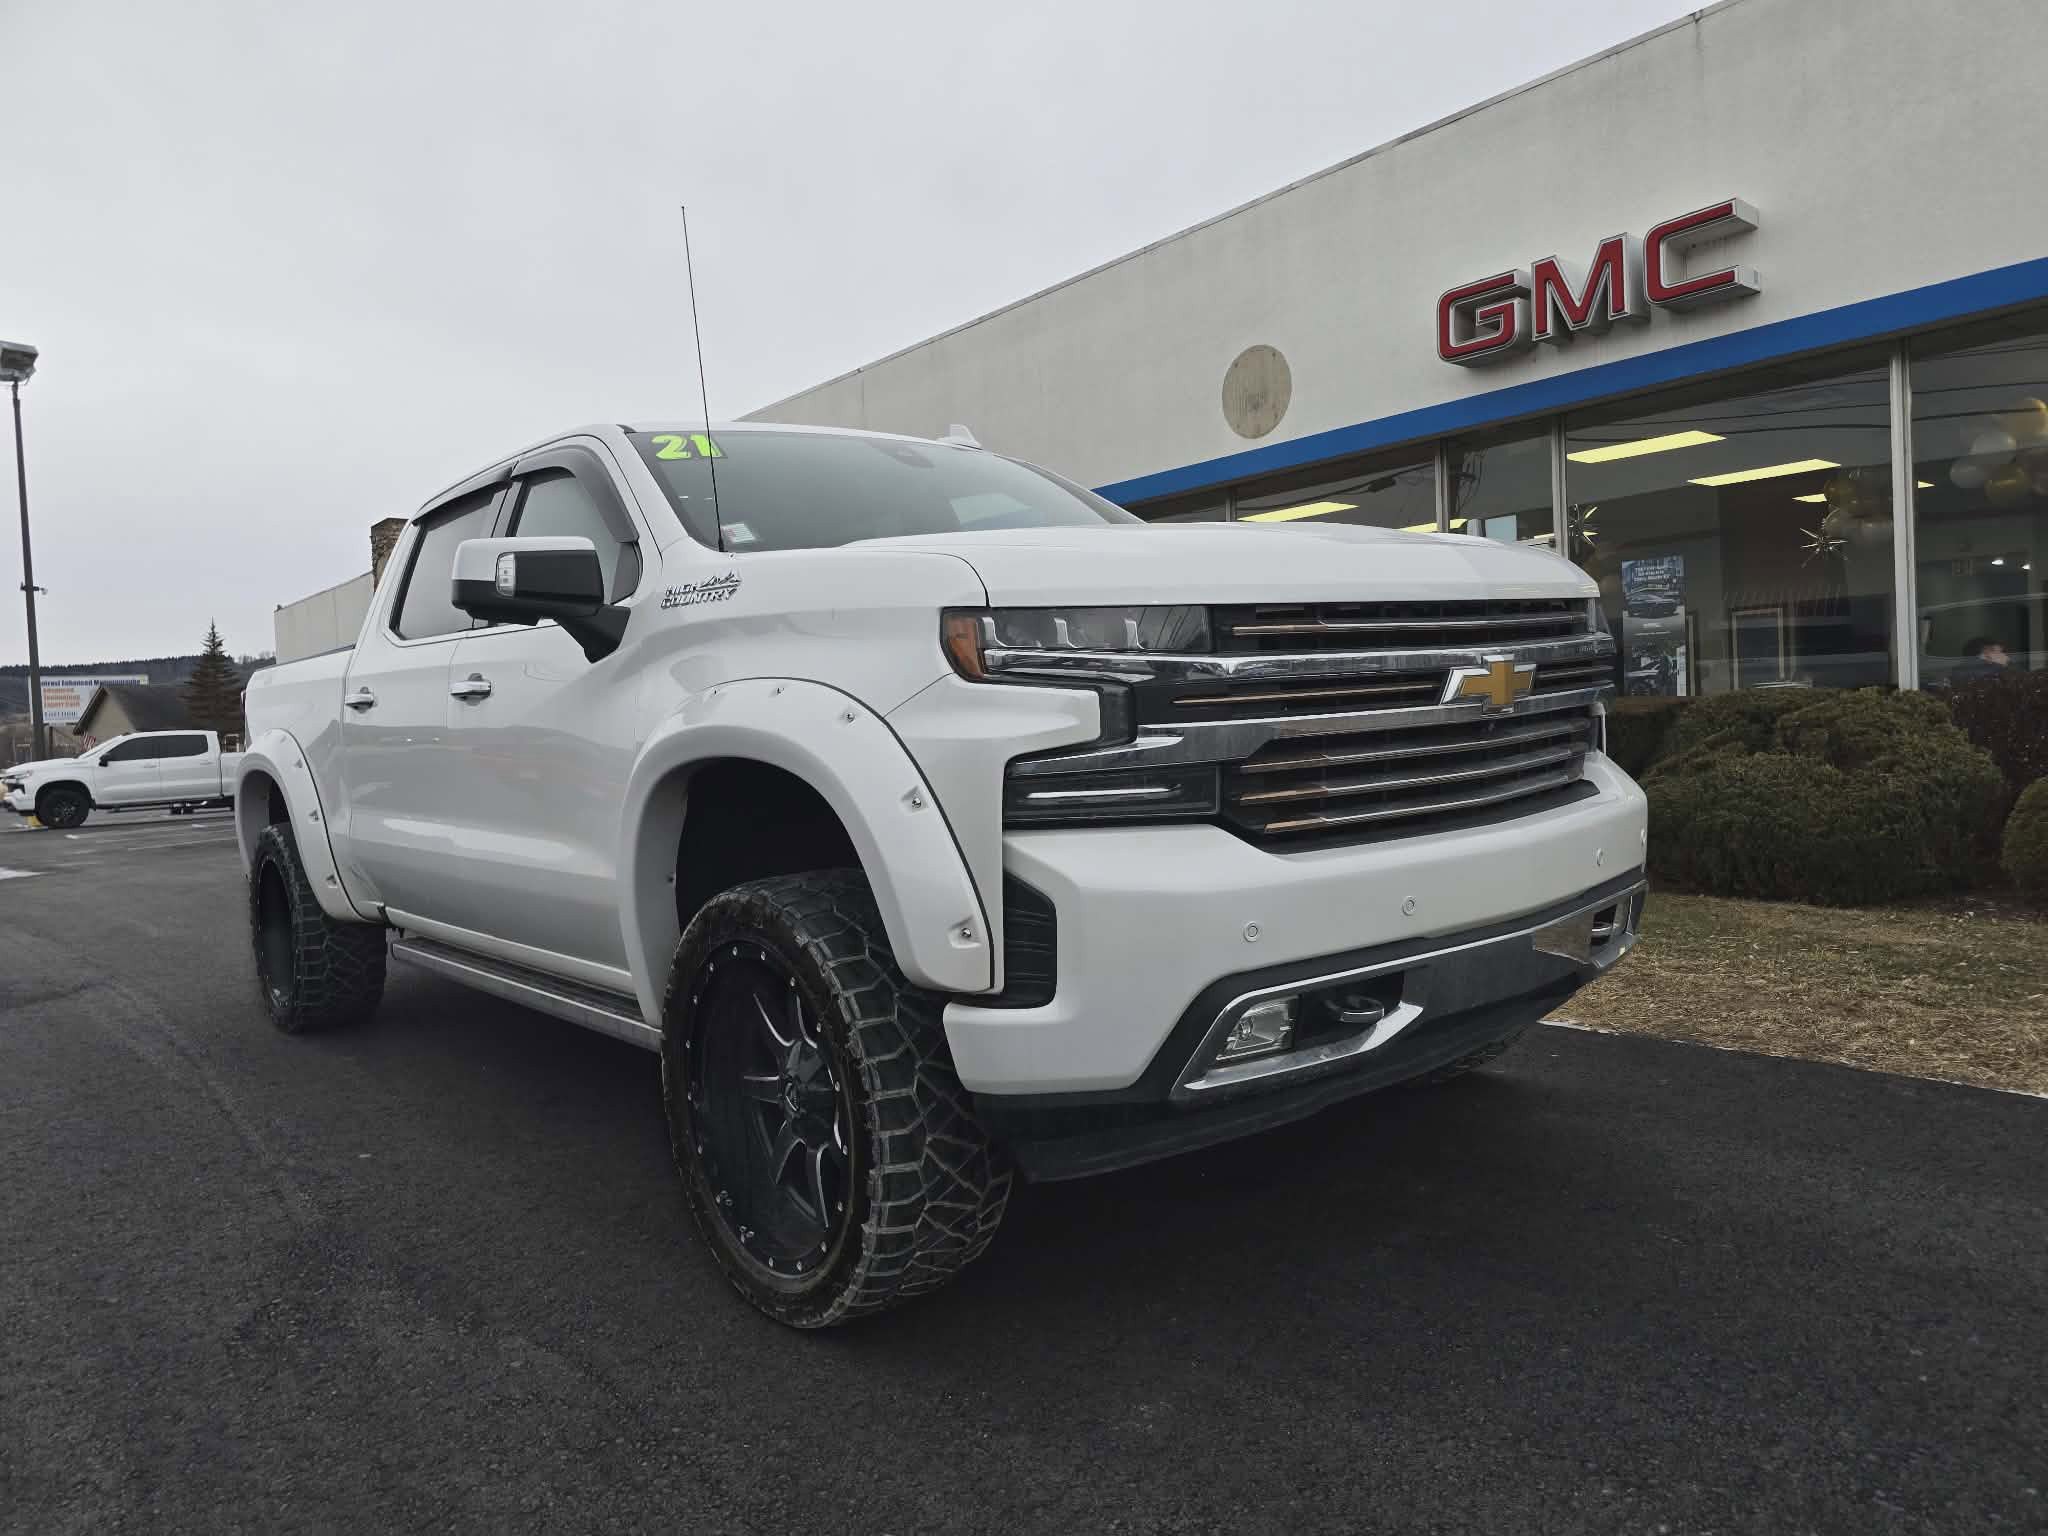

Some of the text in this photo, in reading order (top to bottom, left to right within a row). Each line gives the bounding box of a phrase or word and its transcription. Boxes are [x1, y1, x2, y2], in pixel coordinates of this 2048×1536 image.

[1437, 198, 1757, 366] GMC
[651, 434, 725, 460] 21
[660, 588, 738, 609] COUNTRY
[665, 584, 697, 597] HIGH
